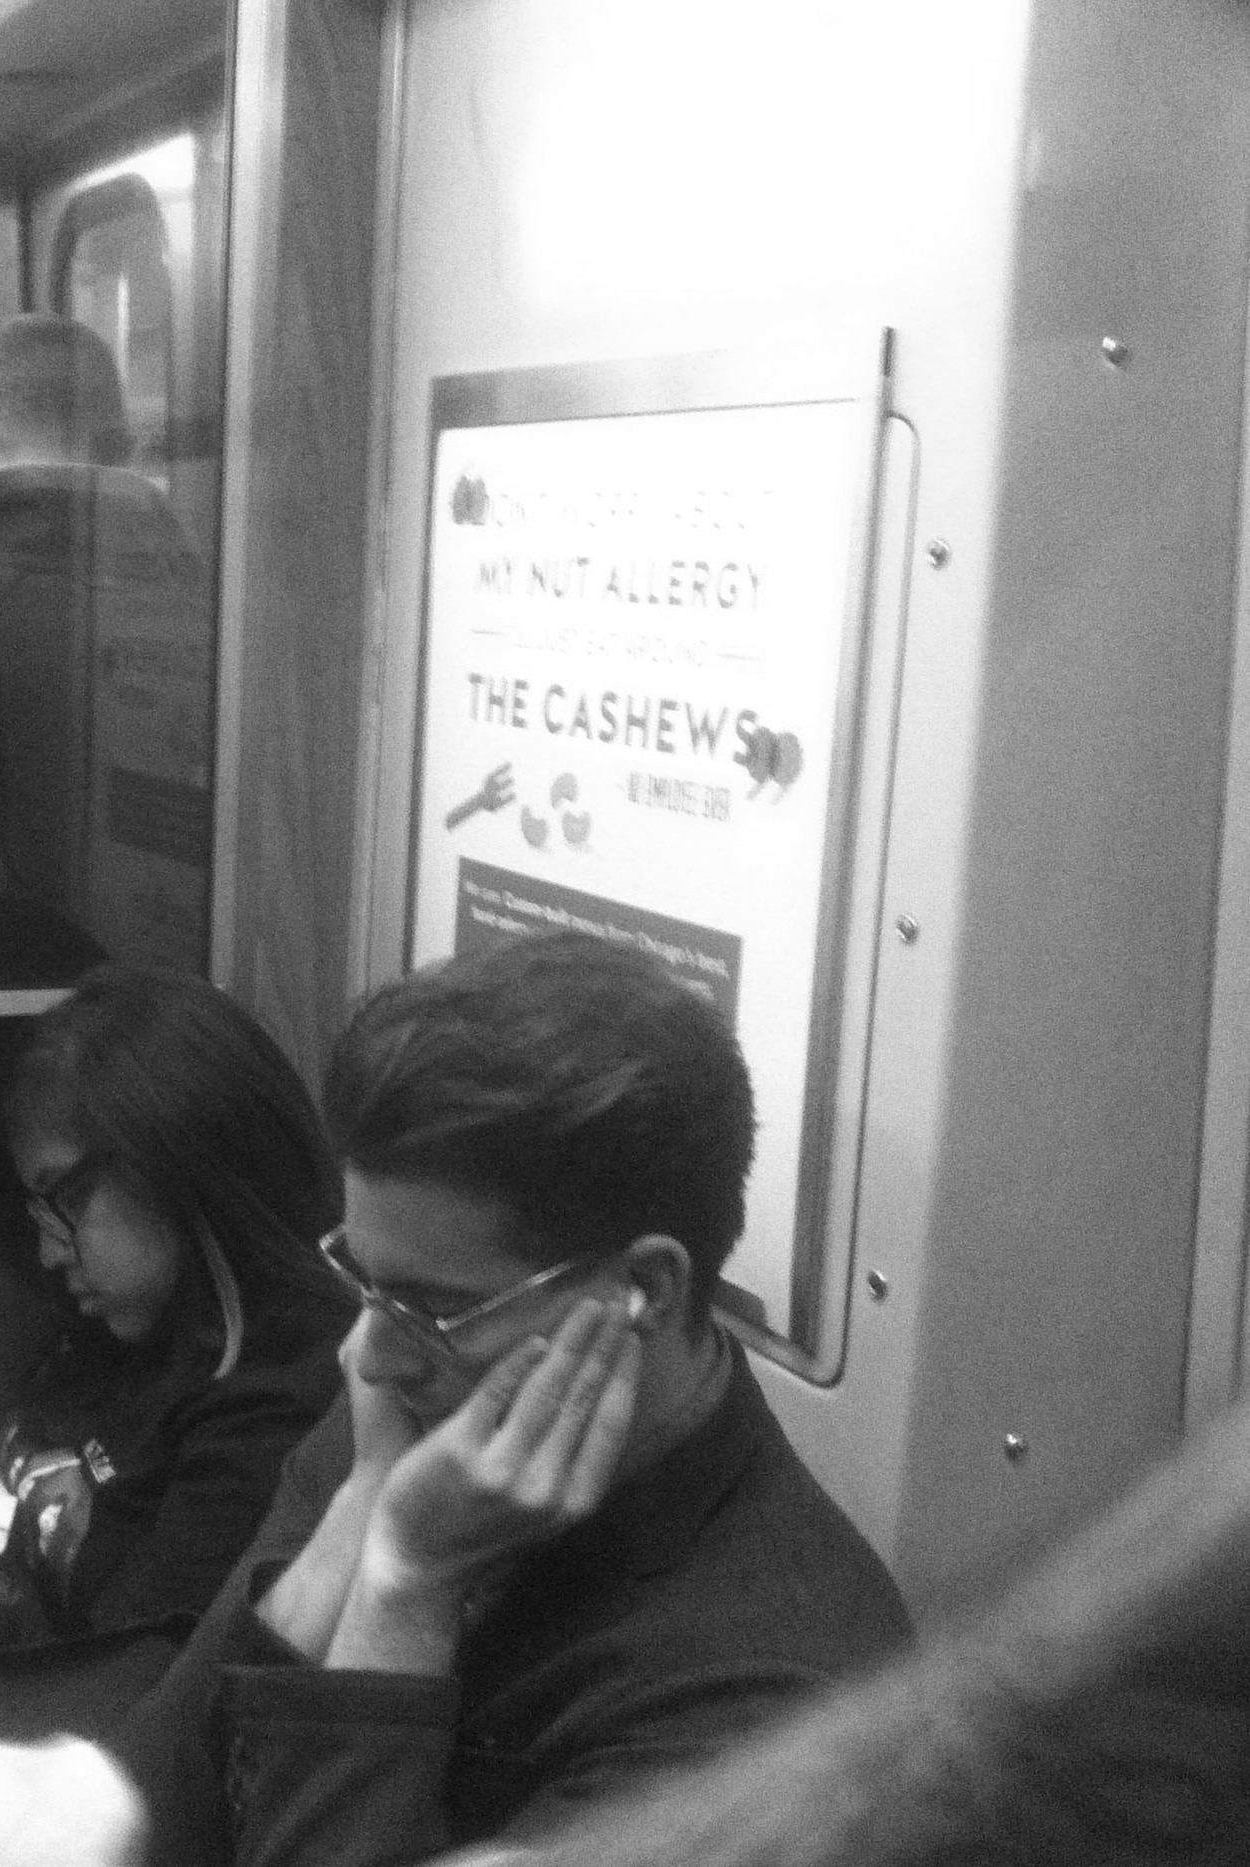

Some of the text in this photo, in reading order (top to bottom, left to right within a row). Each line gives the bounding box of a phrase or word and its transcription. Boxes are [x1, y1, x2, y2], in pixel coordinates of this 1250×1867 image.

[529, 557, 591, 599] NUT
[603, 560, 766, 610] ALLERGY
[468, 672, 759, 766] THE CASHEWS
